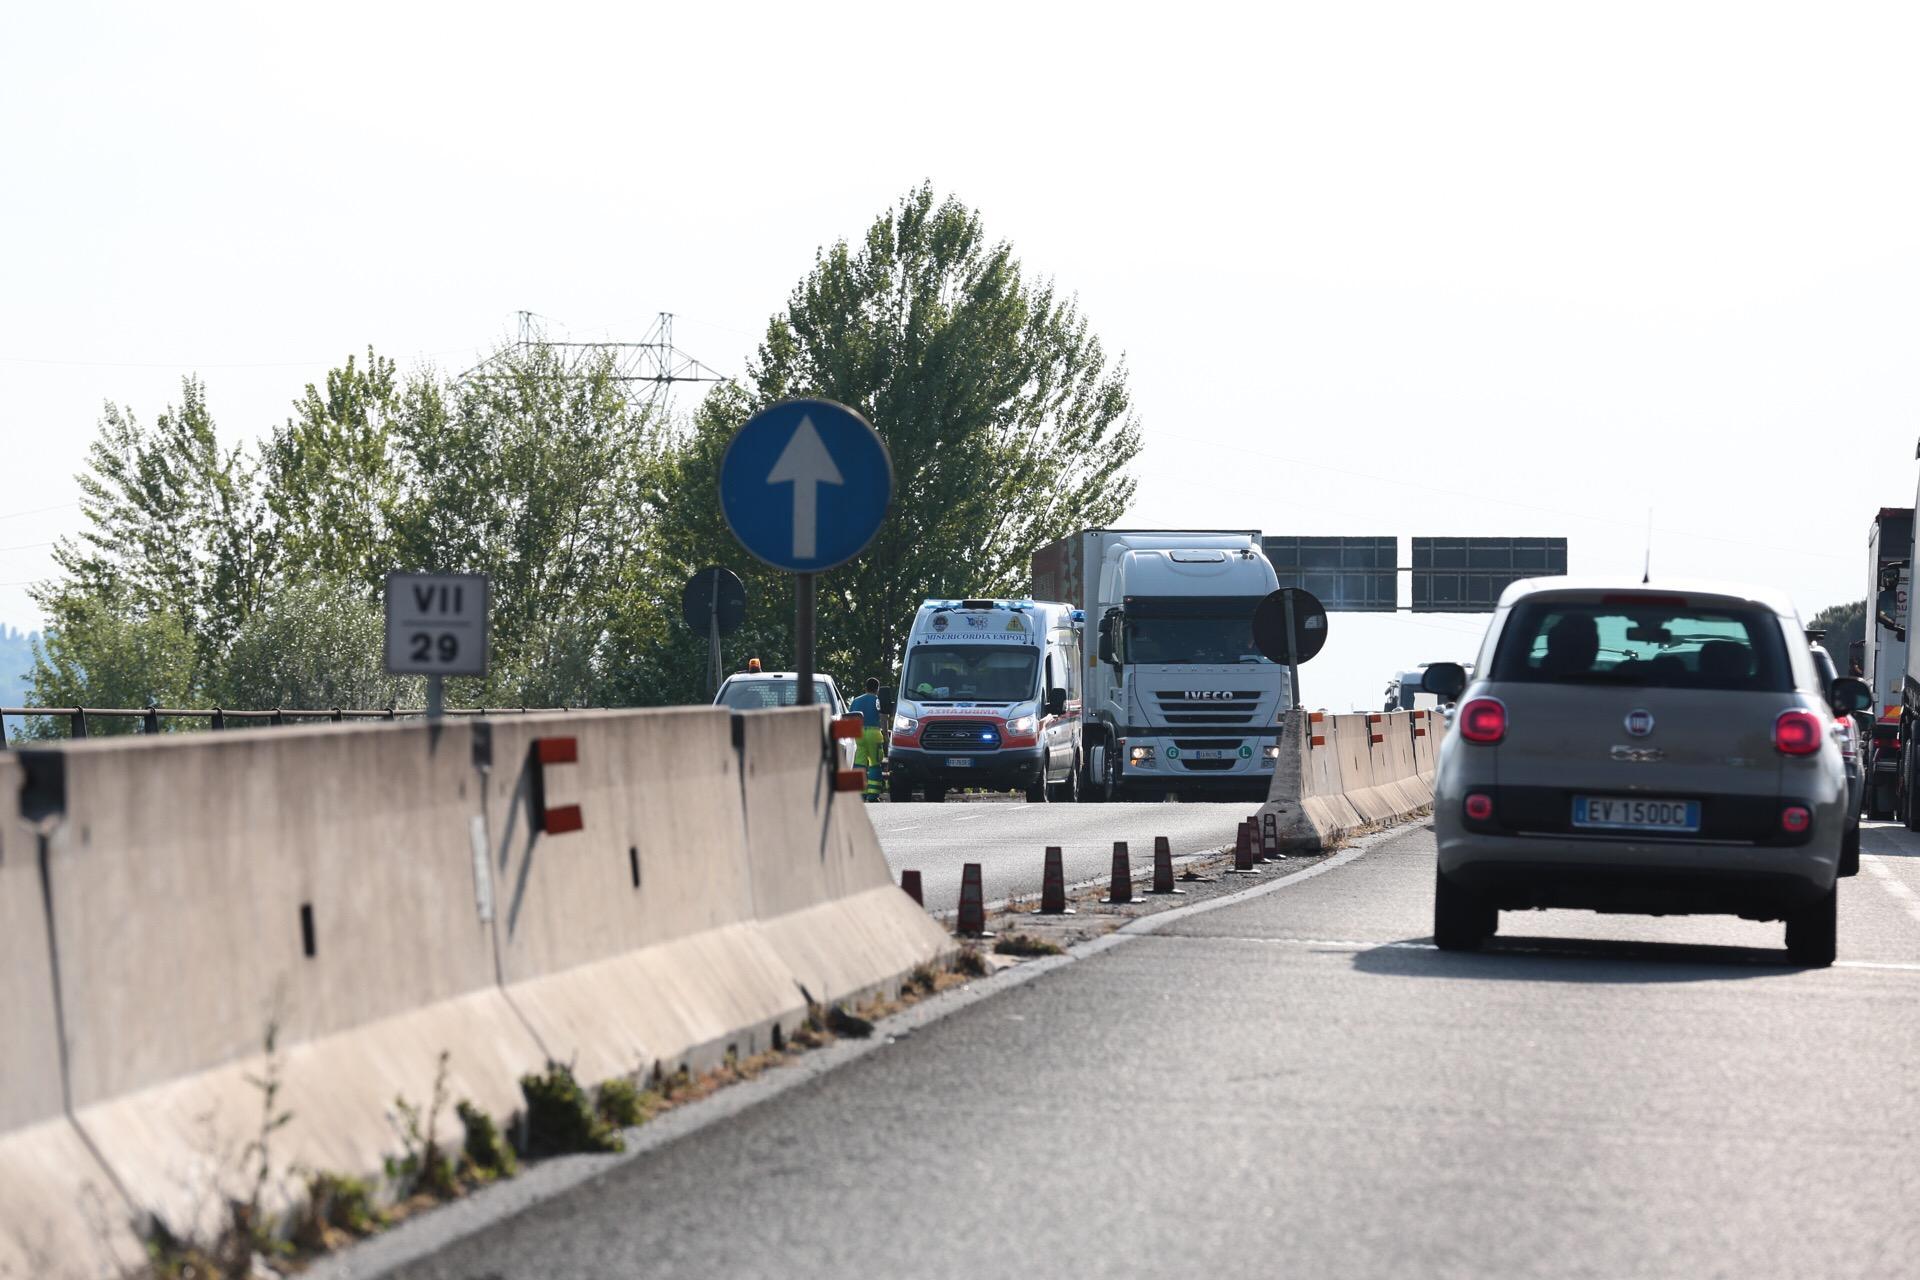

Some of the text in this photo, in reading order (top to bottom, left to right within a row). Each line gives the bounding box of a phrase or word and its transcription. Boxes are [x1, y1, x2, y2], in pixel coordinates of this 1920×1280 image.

[413, 584, 463, 613] VII
[410, 632, 459, 663] 29
[1184, 691, 1233, 701] IVECO
[1168, 749, 1177, 757] G
[1242, 749, 1249, 757] L
[1590, 800, 1613, 820] EV
